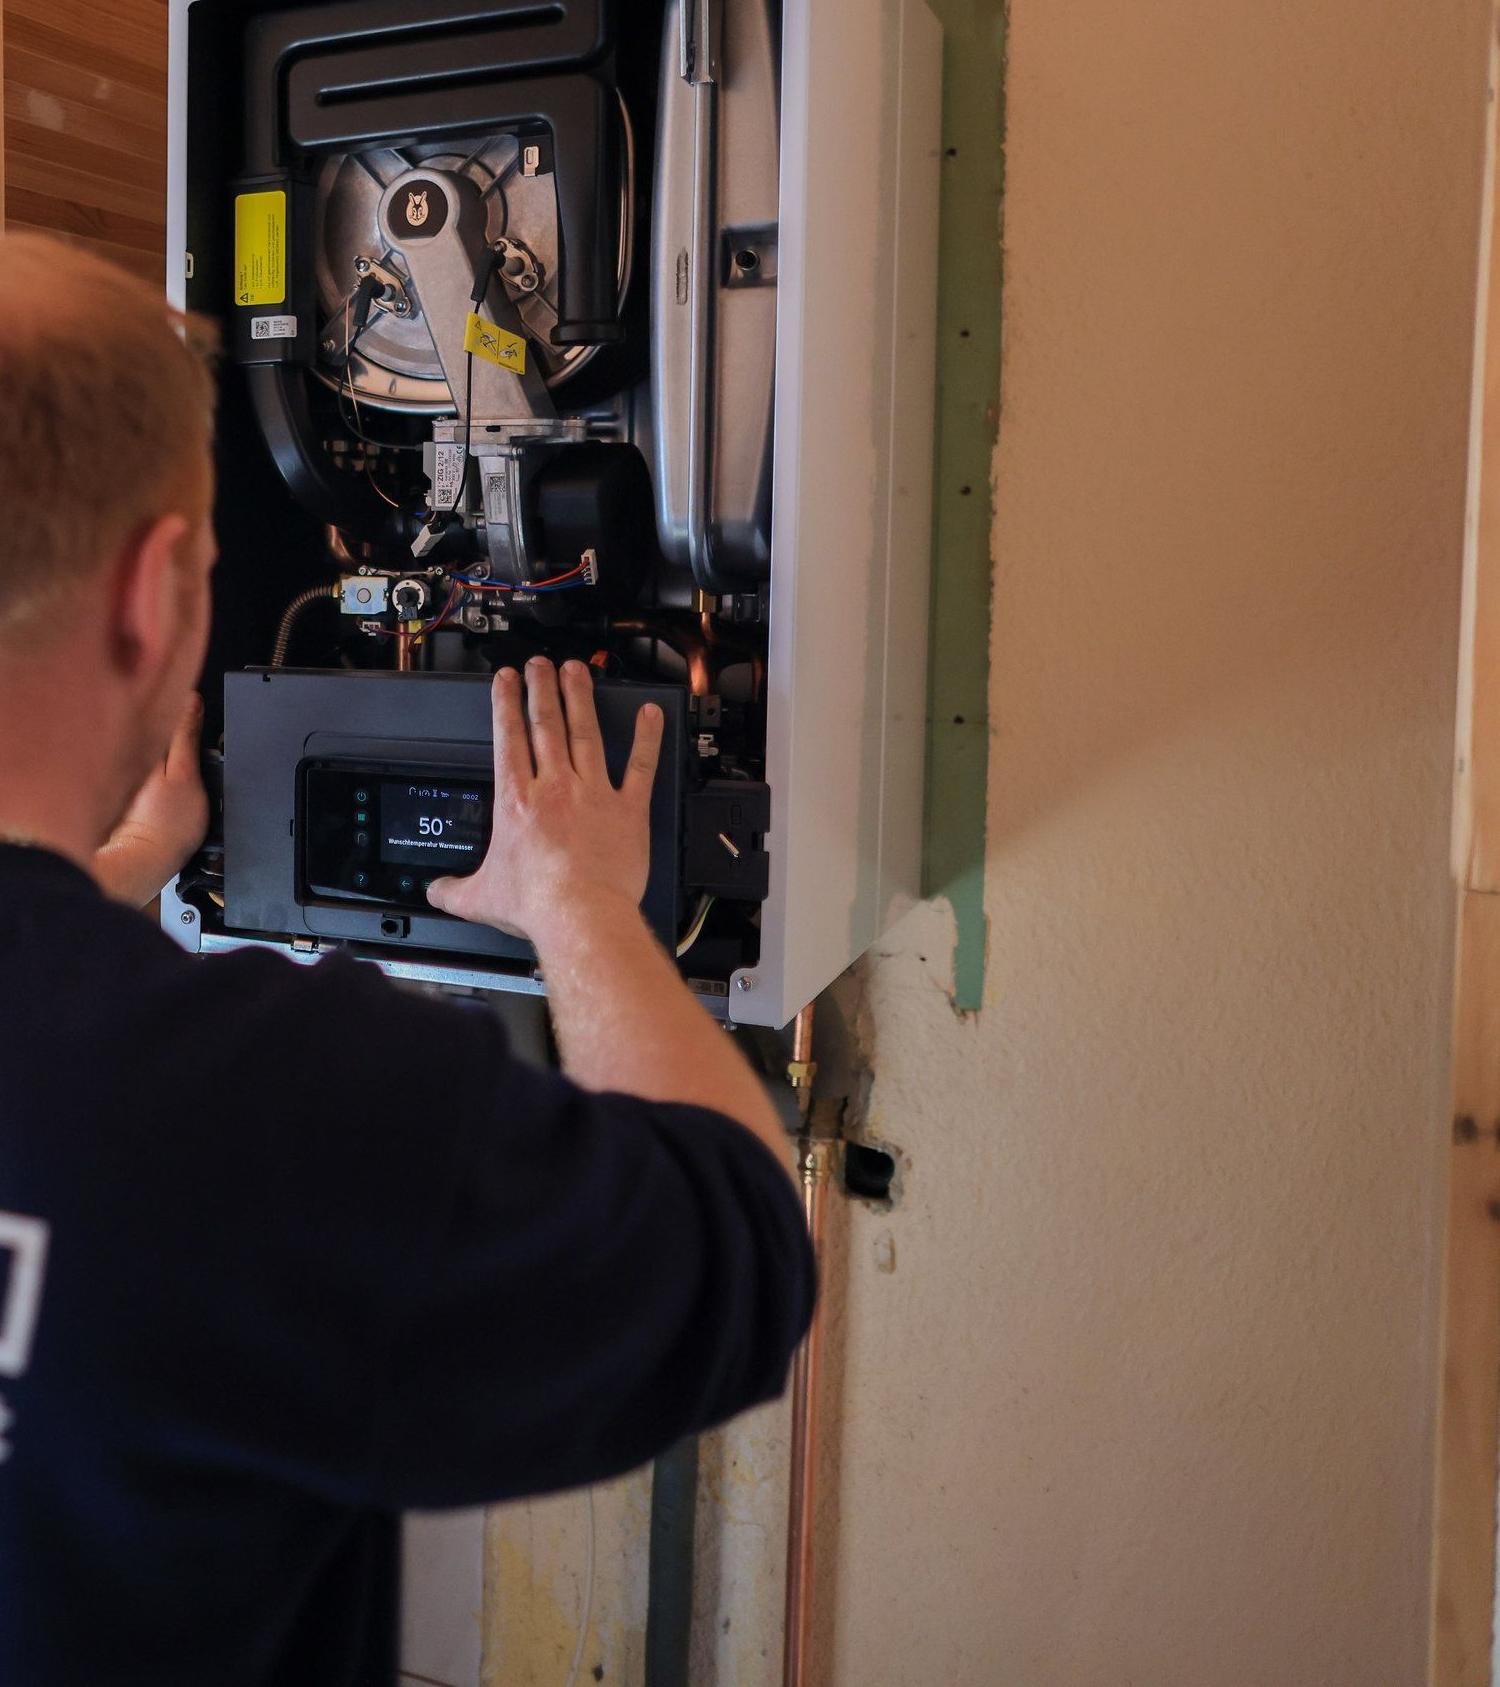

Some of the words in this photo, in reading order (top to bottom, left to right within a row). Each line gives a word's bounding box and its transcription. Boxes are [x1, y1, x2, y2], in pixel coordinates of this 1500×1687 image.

[419, 817, 443, 836] 50
[388, 838, 438, 848] Wunschtemperatur
[439, 841, 473, 851] Warmwasser
